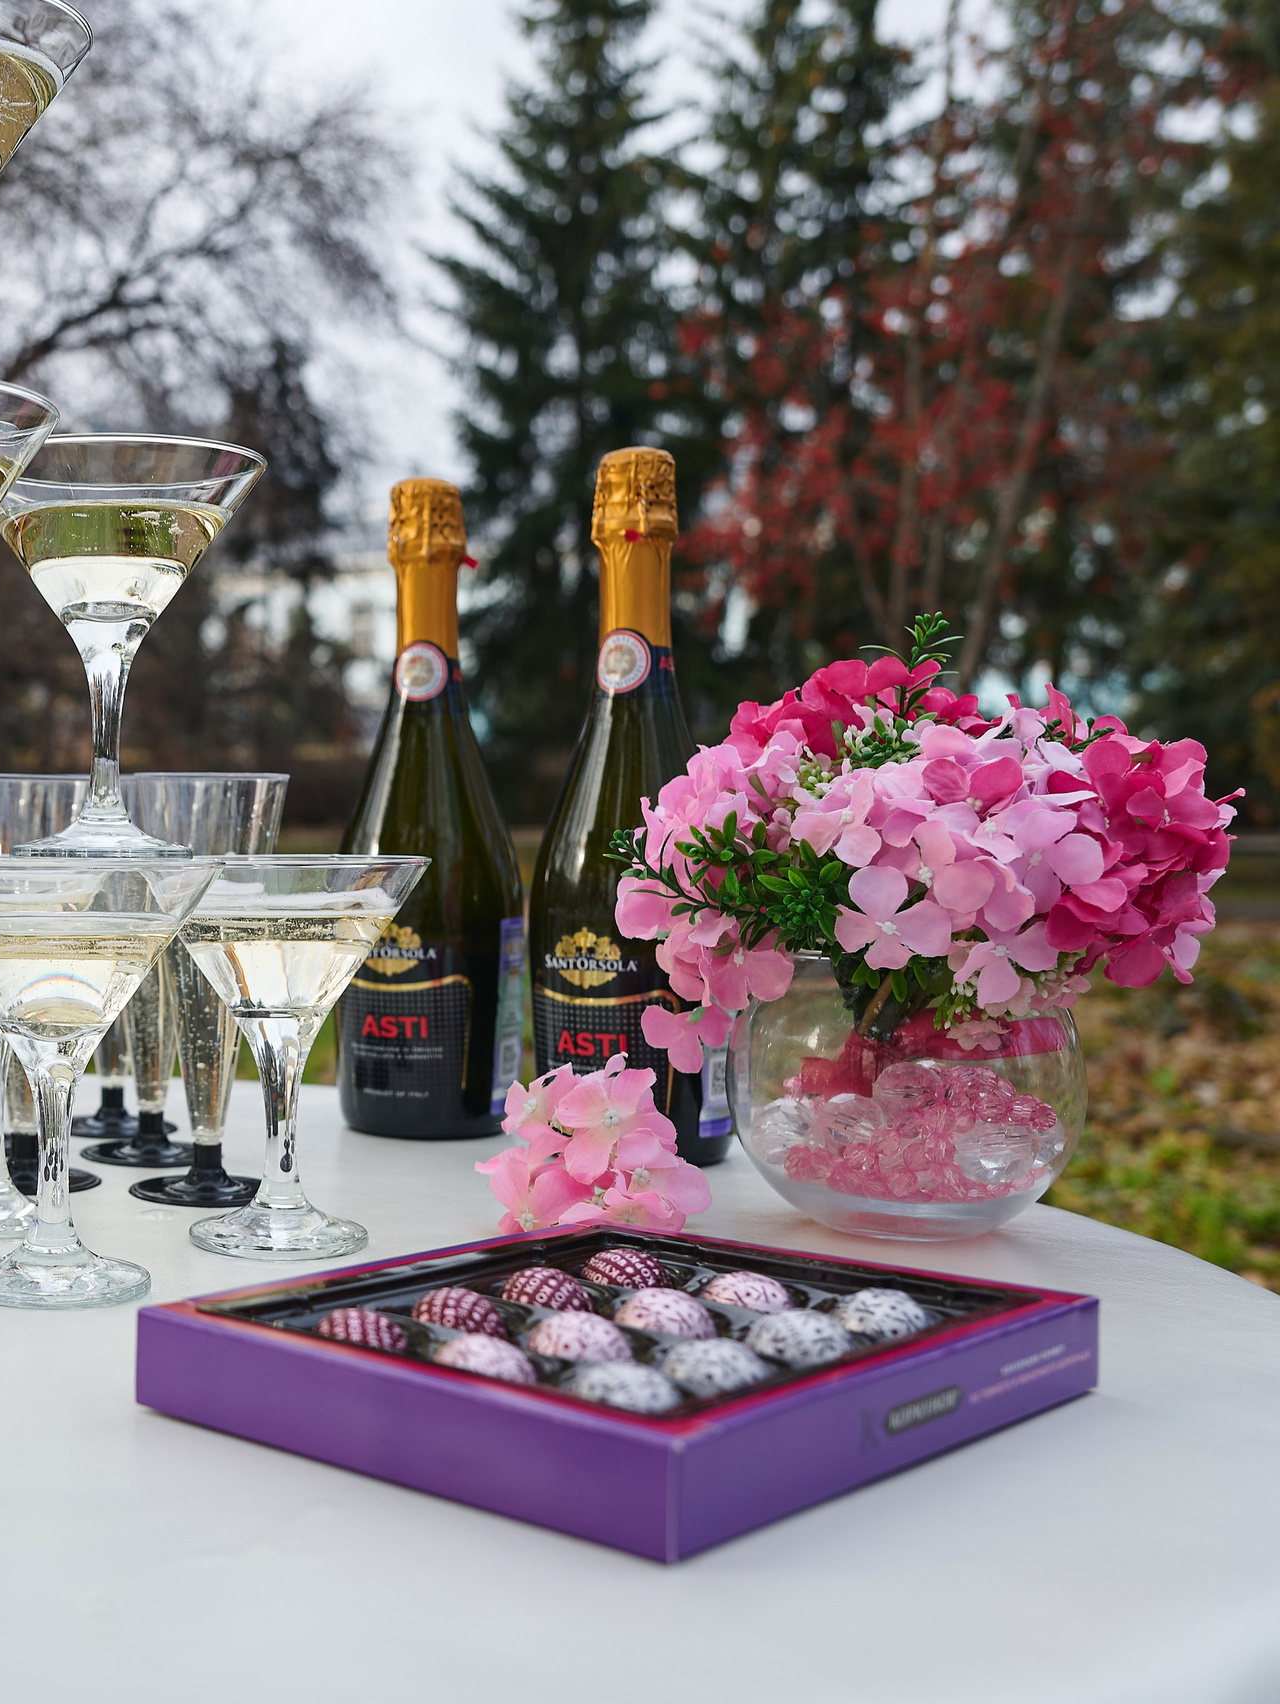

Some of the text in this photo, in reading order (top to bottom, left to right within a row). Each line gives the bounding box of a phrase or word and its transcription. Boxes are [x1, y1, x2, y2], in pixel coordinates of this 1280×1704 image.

[368, 946, 437, 960] TORSOLA
[362, 1014, 428, 1039] ASTI
[557, 1030, 627, 1057] ASTI
